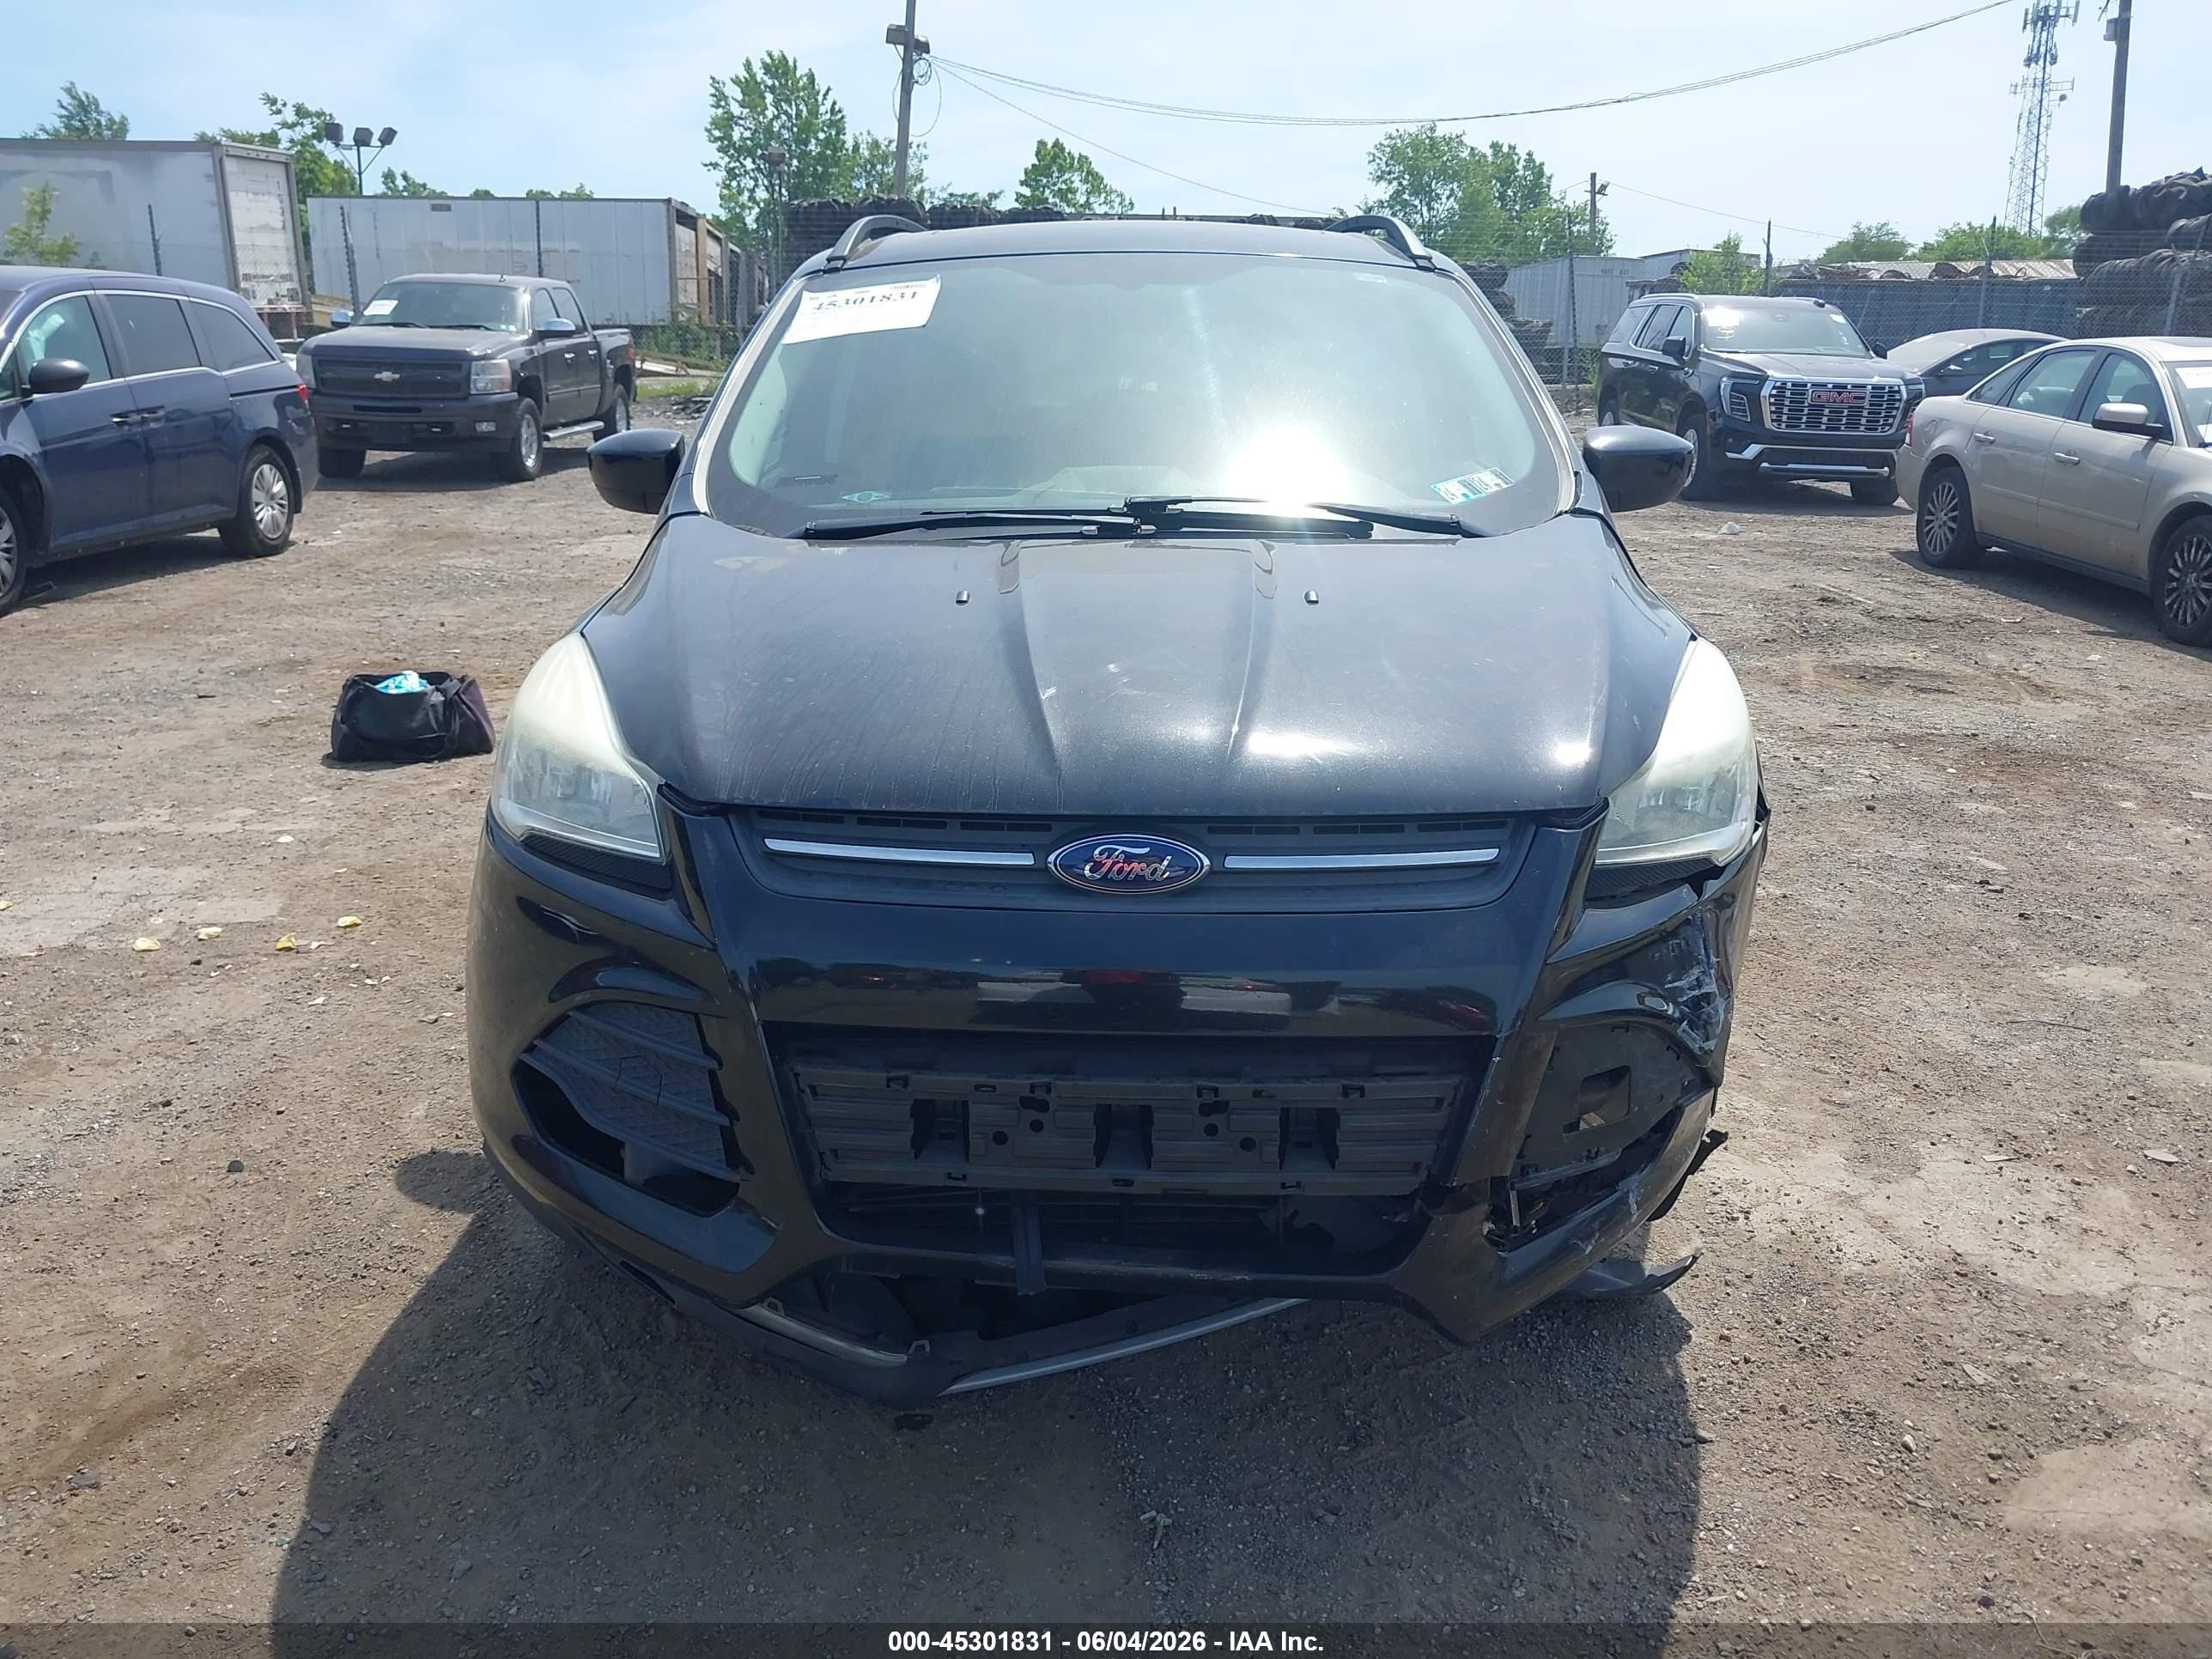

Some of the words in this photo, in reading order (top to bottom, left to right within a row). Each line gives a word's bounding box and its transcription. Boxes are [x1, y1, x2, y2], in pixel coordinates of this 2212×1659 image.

[811, 290, 918, 312] 45301831
[1813, 391, 1866, 404] GMC
[1084, 844, 1172, 881] Ford
